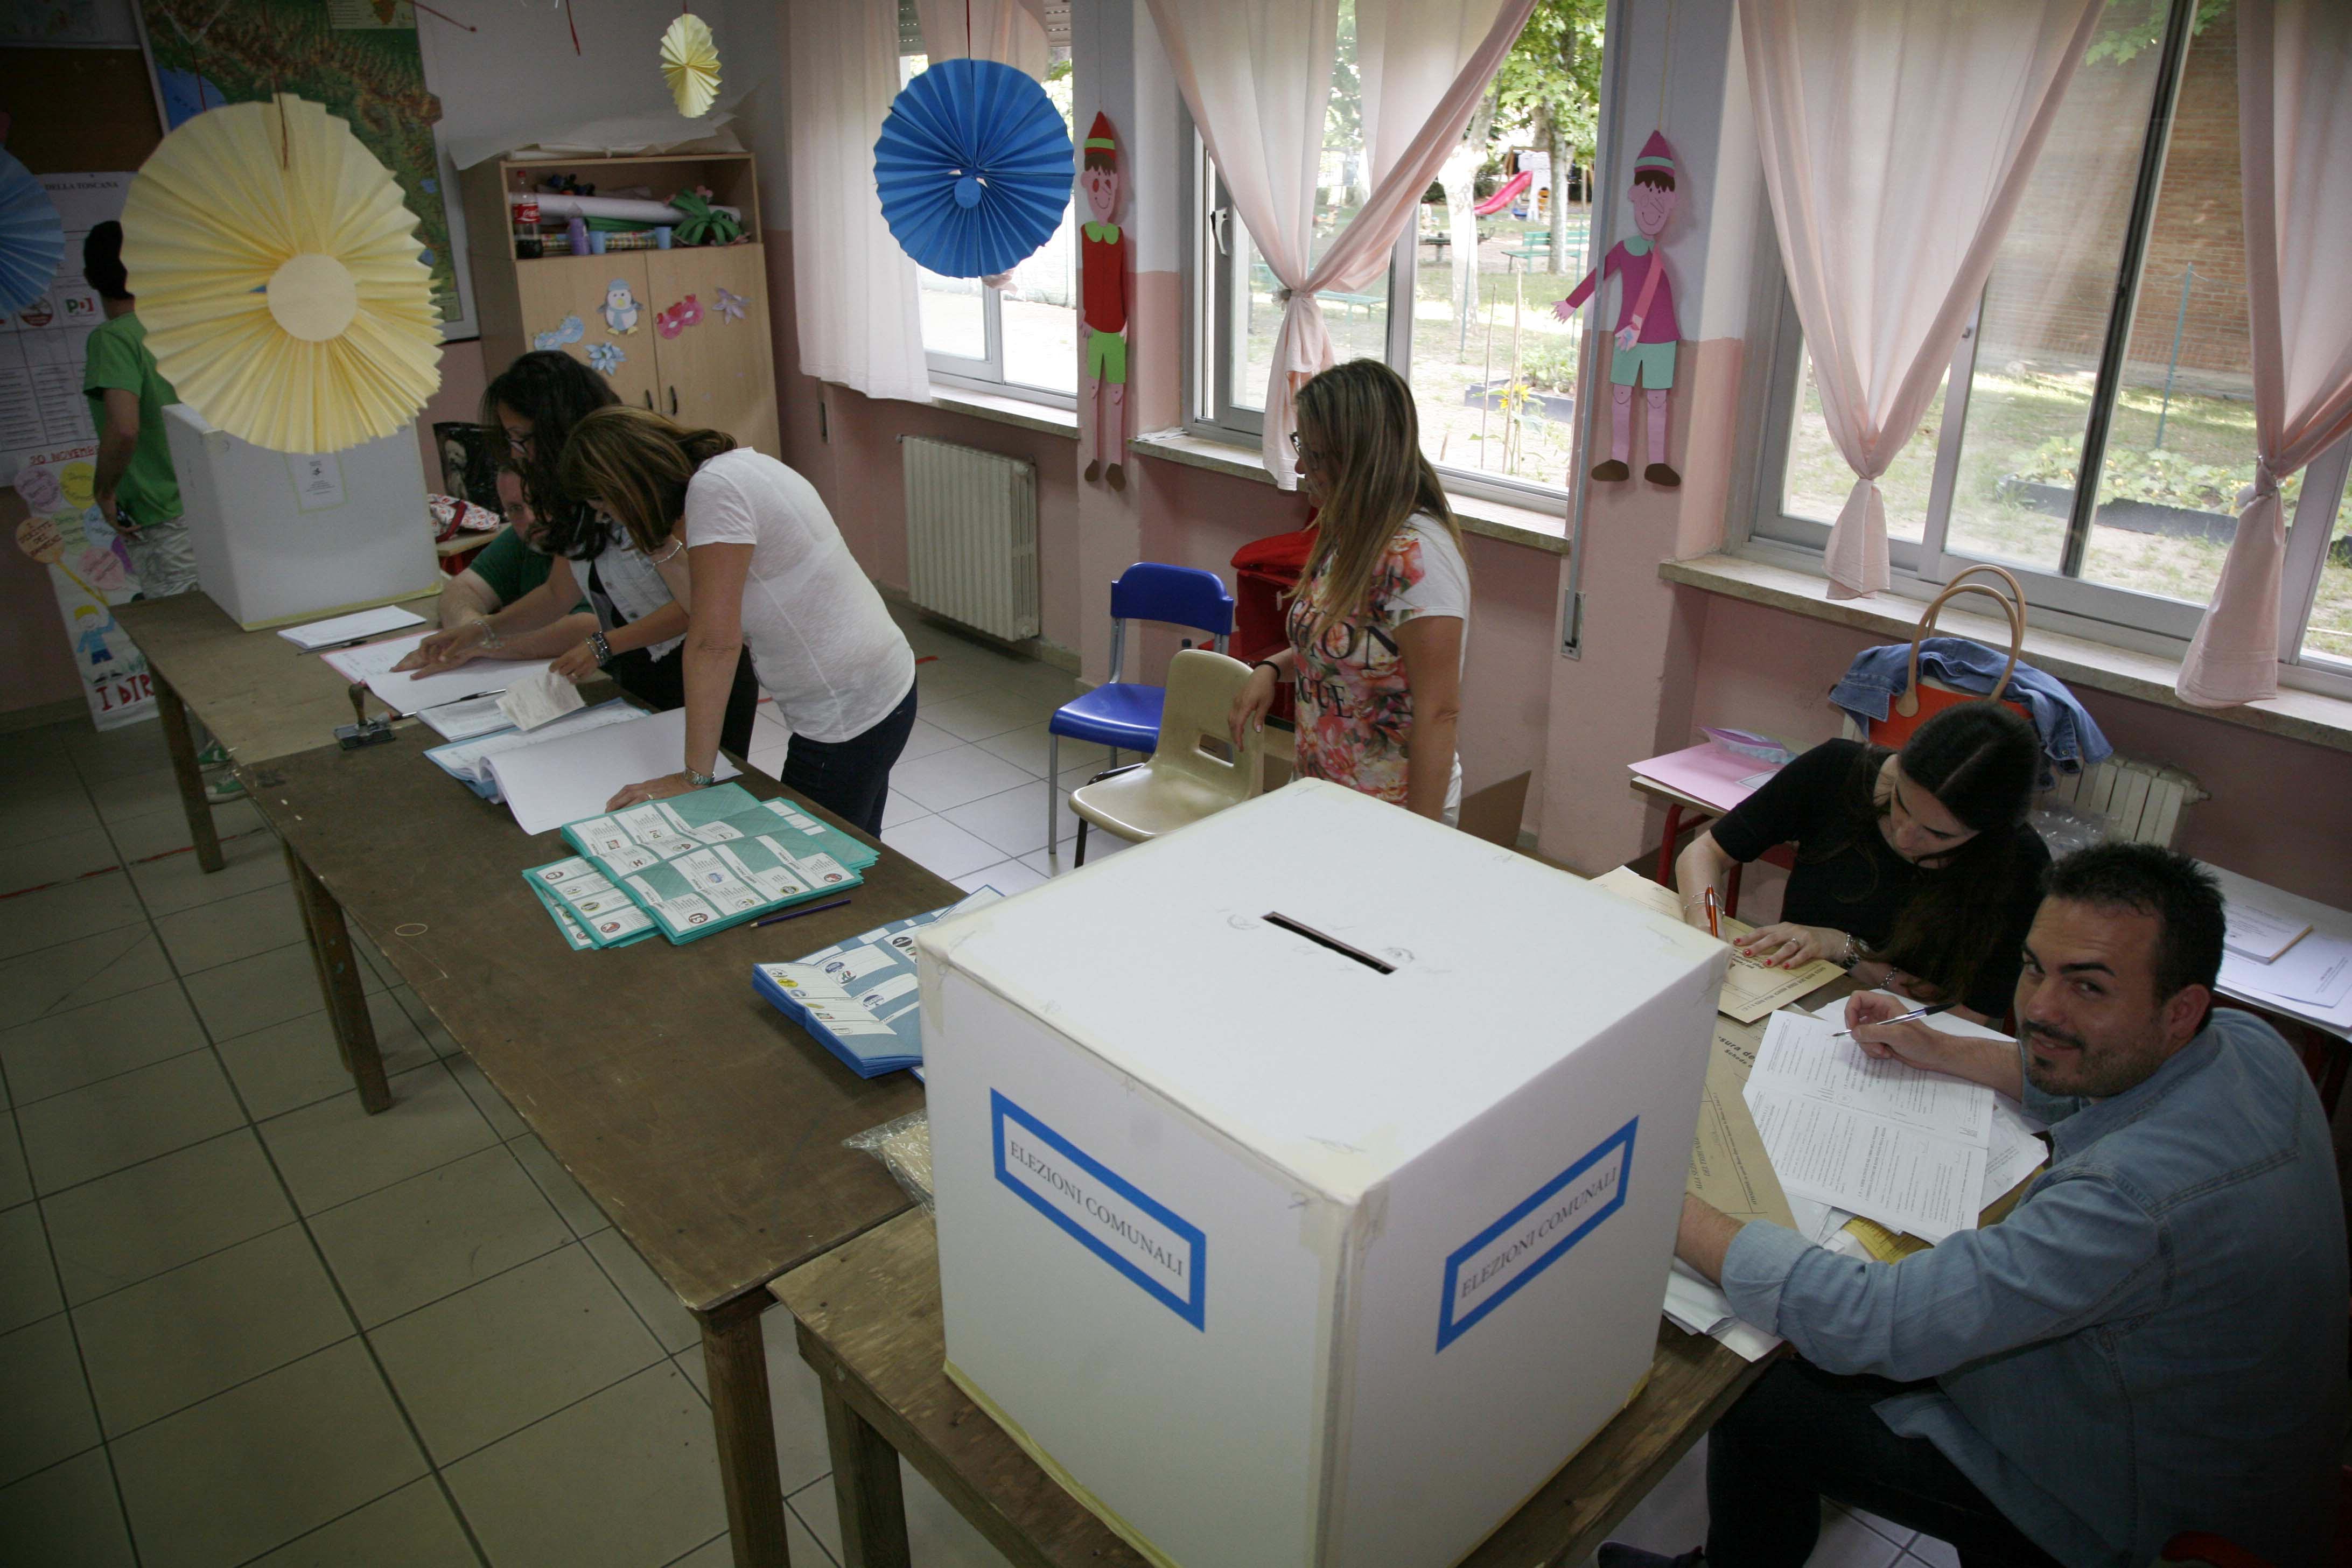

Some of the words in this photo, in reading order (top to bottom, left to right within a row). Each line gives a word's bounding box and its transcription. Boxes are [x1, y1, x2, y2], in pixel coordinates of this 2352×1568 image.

[1010, 1140, 1082, 1206] ELEZIONI
[1086, 1196, 1183, 1277] COMUNALI
[1460, 1230, 1537, 1299] ELEZIONI
[1538, 1167, 1618, 1239] COMUNALI
